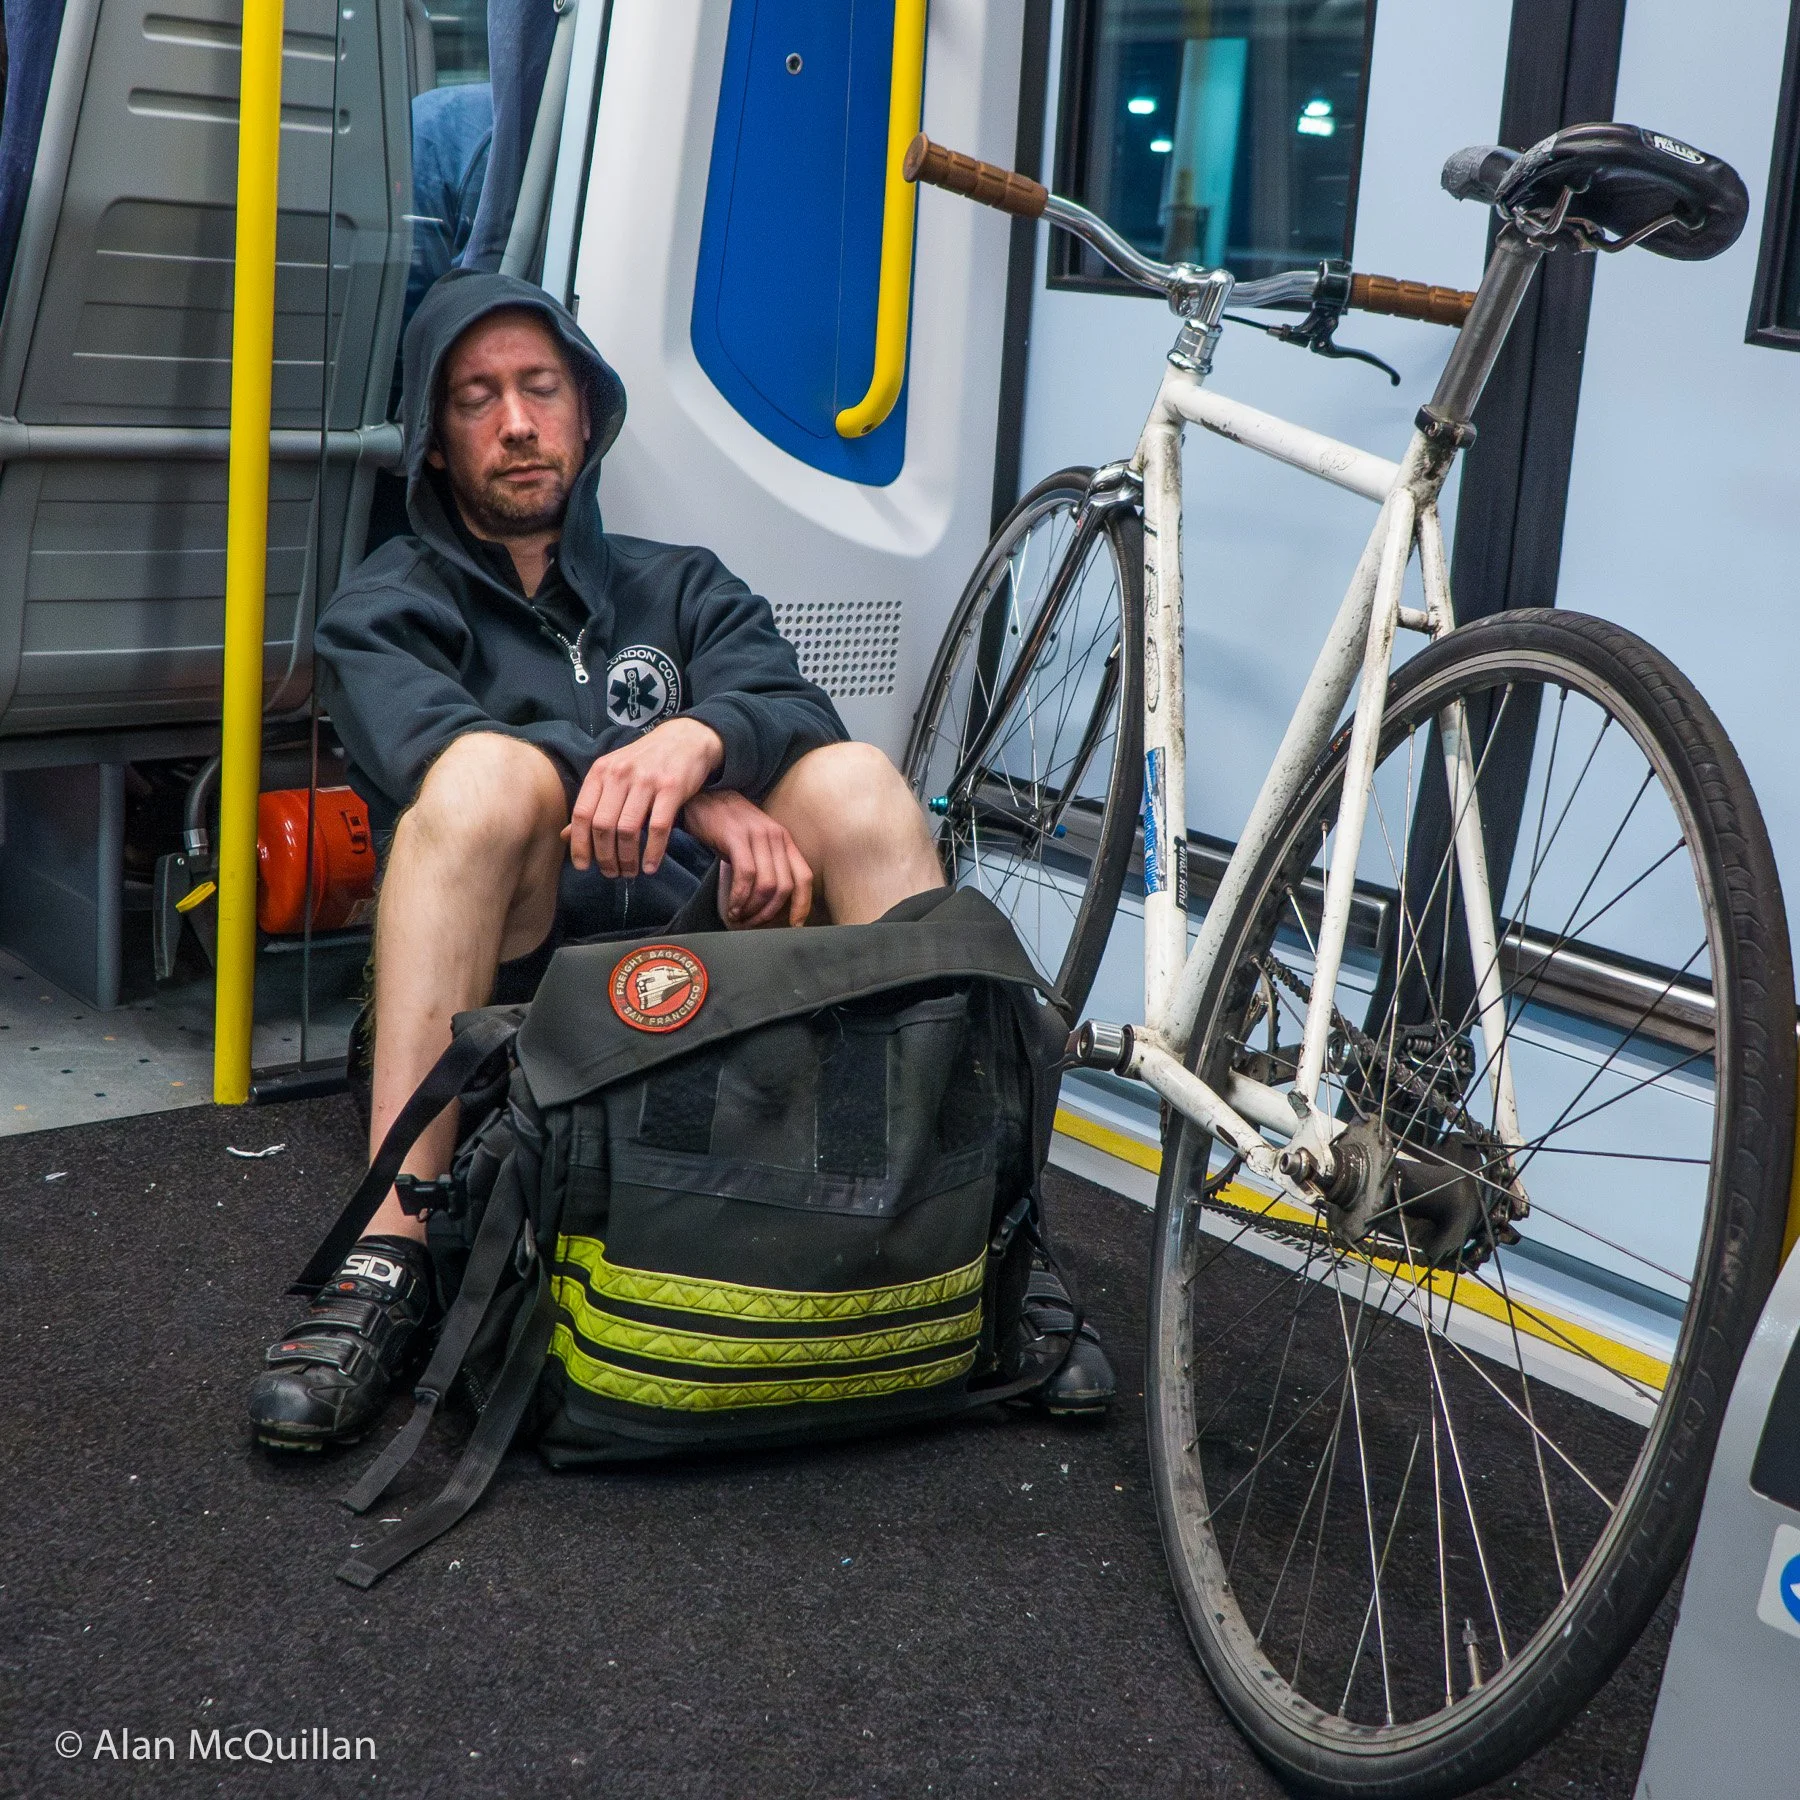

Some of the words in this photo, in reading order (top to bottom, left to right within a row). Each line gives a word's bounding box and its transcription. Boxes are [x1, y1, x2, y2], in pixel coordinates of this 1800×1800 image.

[658, 660, 677, 717] COURIER
[1178, 877, 1188, 907] FUCK
[616, 954, 643, 996] FREIGHT
[649, 951, 698, 974] BAGGAGE
[623, 1006, 644, 1023] SAN
[649, 985, 700, 1025] FRANCISCO
[340, 1254, 403, 1288] SIDI
